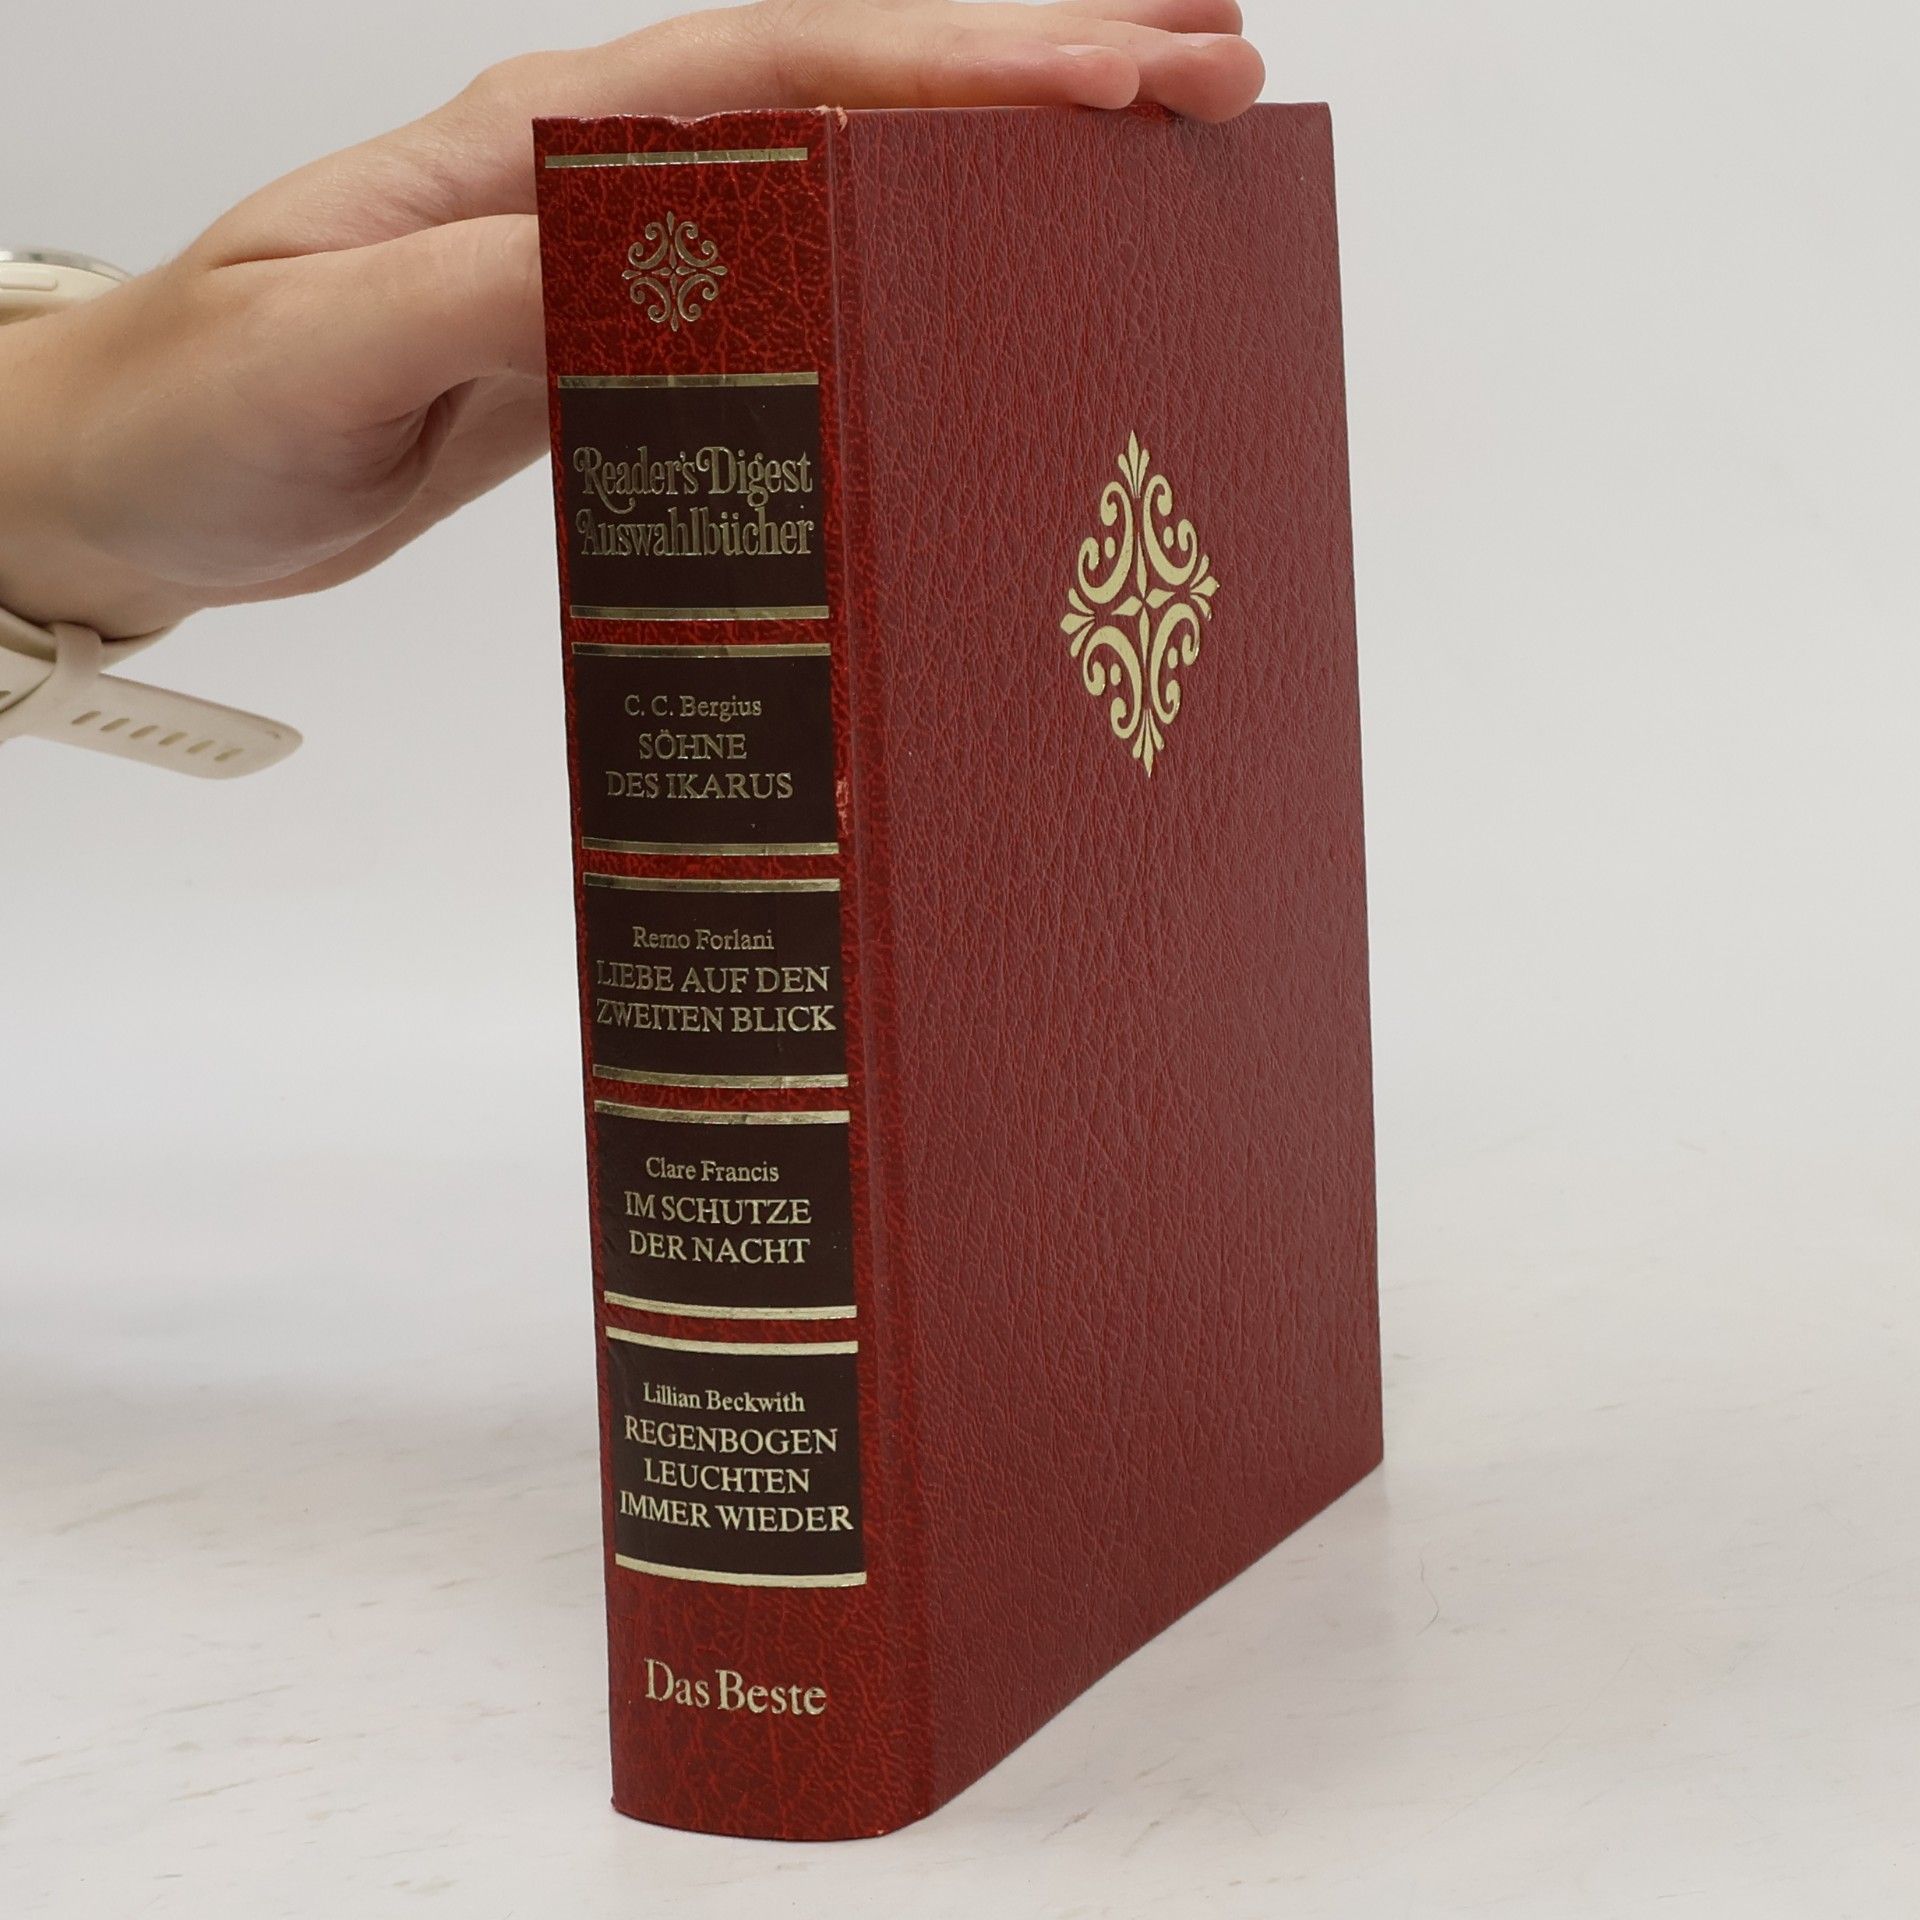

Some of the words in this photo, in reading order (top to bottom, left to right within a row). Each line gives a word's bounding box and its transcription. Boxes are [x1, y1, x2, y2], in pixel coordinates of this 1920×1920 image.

[573, 446, 699, 514] Reader's
[696, 446, 813, 507] Digest
[575, 507, 815, 556] Auswahlbücher
[624, 694, 645, 716] C.
[651, 695, 673, 716] C.
[679, 695, 762, 722] Bergius
[638, 729, 747, 760] SÖHNE
[606, 771, 659, 798] DES
[665, 772, 793, 799] IKARUS
[632, 926, 690, 949] Remo
[695, 928, 774, 950] Forlani
[597, 960, 674, 992] LIEBE
[680, 966, 750, 993] AUF
[755, 966, 830, 993] DEN
[596, 998, 723, 1032] ZWEITEN
[731, 1005, 836, 1032] BLICK
[646, 1157, 696, 1180] Clare
[700, 1160, 779, 1182] Francis
[624, 1191, 656, 1219] IM
[661, 1196, 812, 1225] SCHUTZE
[629, 1230, 687, 1260] DER
[691, 1237, 811, 1264] NACHT
[643, 1382, 701, 1409] Lillian
[705, 1390, 805, 1413] Beckwith
[624, 1415, 838, 1454] REGENBOGEN
[644, 1458, 810, 1493] LEUCHTEN
[620, 1490, 711, 1528] IMMER
[715, 1505, 854, 1532] WIEDER
[643, 1657, 710, 1708] Das
[715, 1669, 827, 1715] Beste
